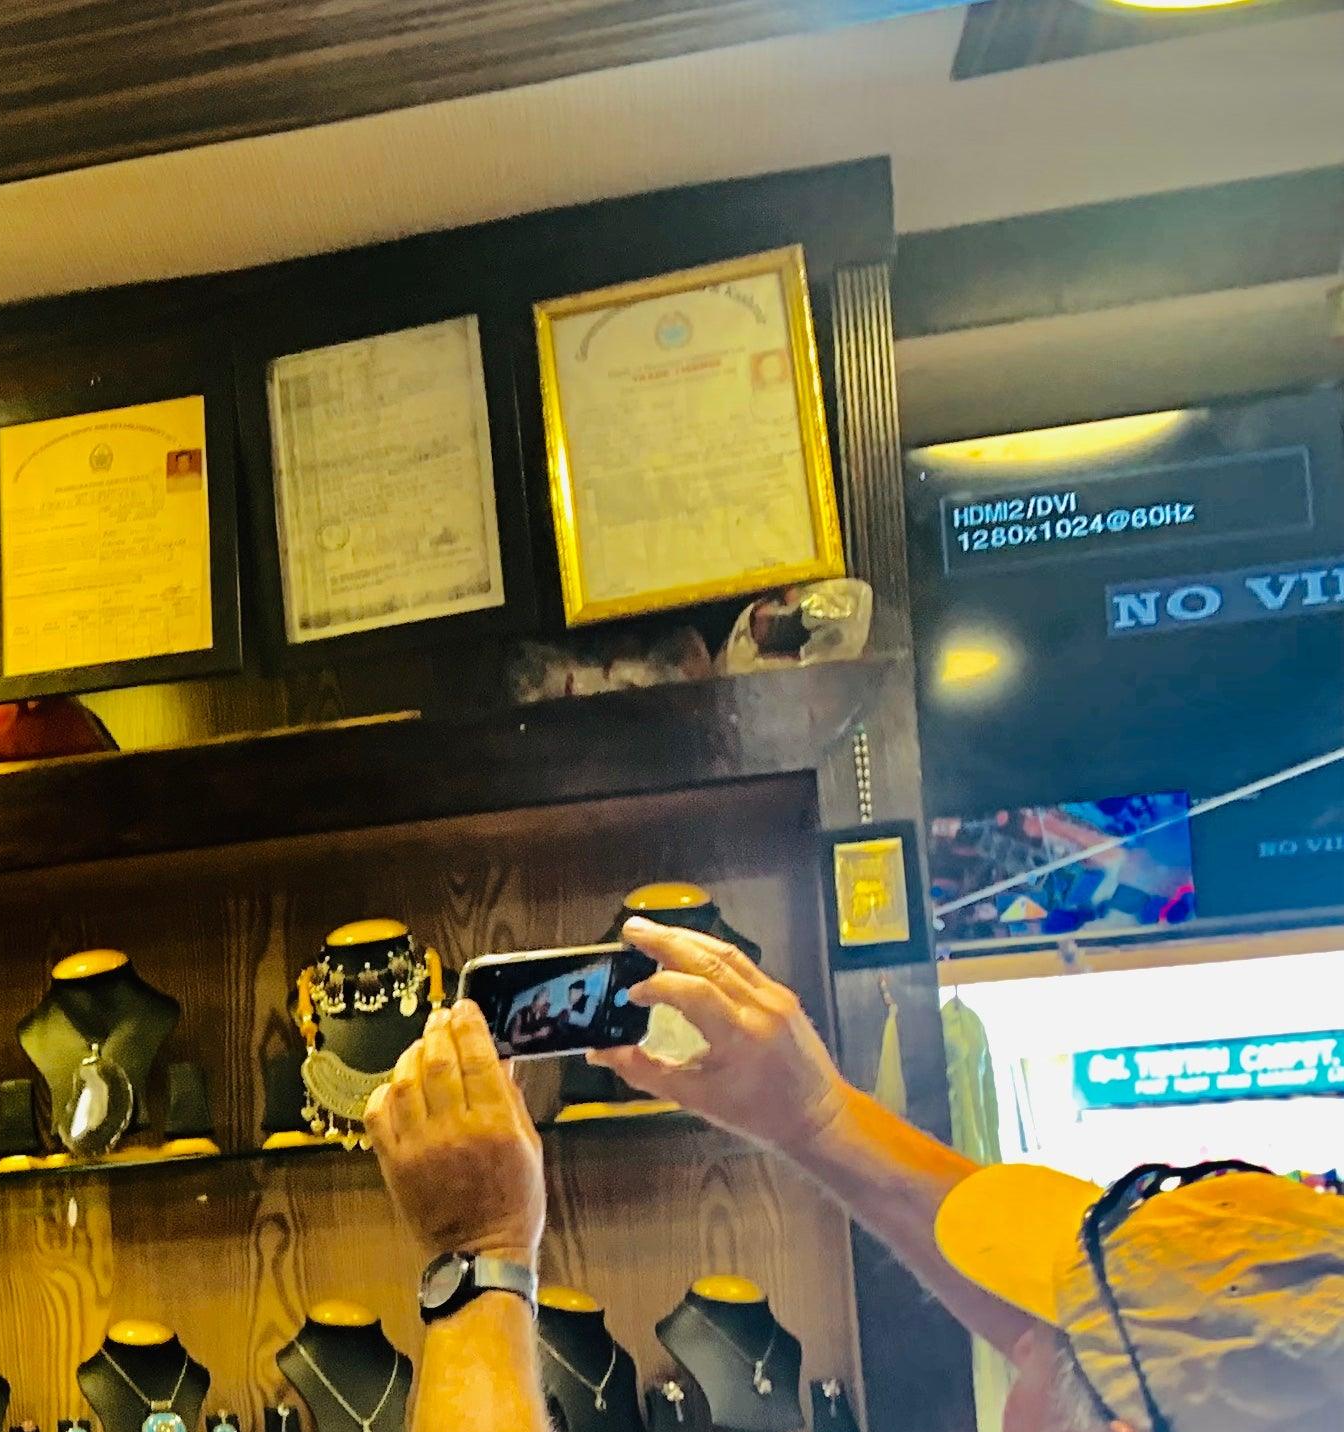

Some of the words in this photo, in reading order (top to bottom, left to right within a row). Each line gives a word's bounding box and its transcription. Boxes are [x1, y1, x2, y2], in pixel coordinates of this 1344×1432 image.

[953, 492, 1077, 528] HDMI2/DVI
[957, 503, 1195, 551] 1280x1024@60Hz
[1112, 585, 1223, 629] NO
